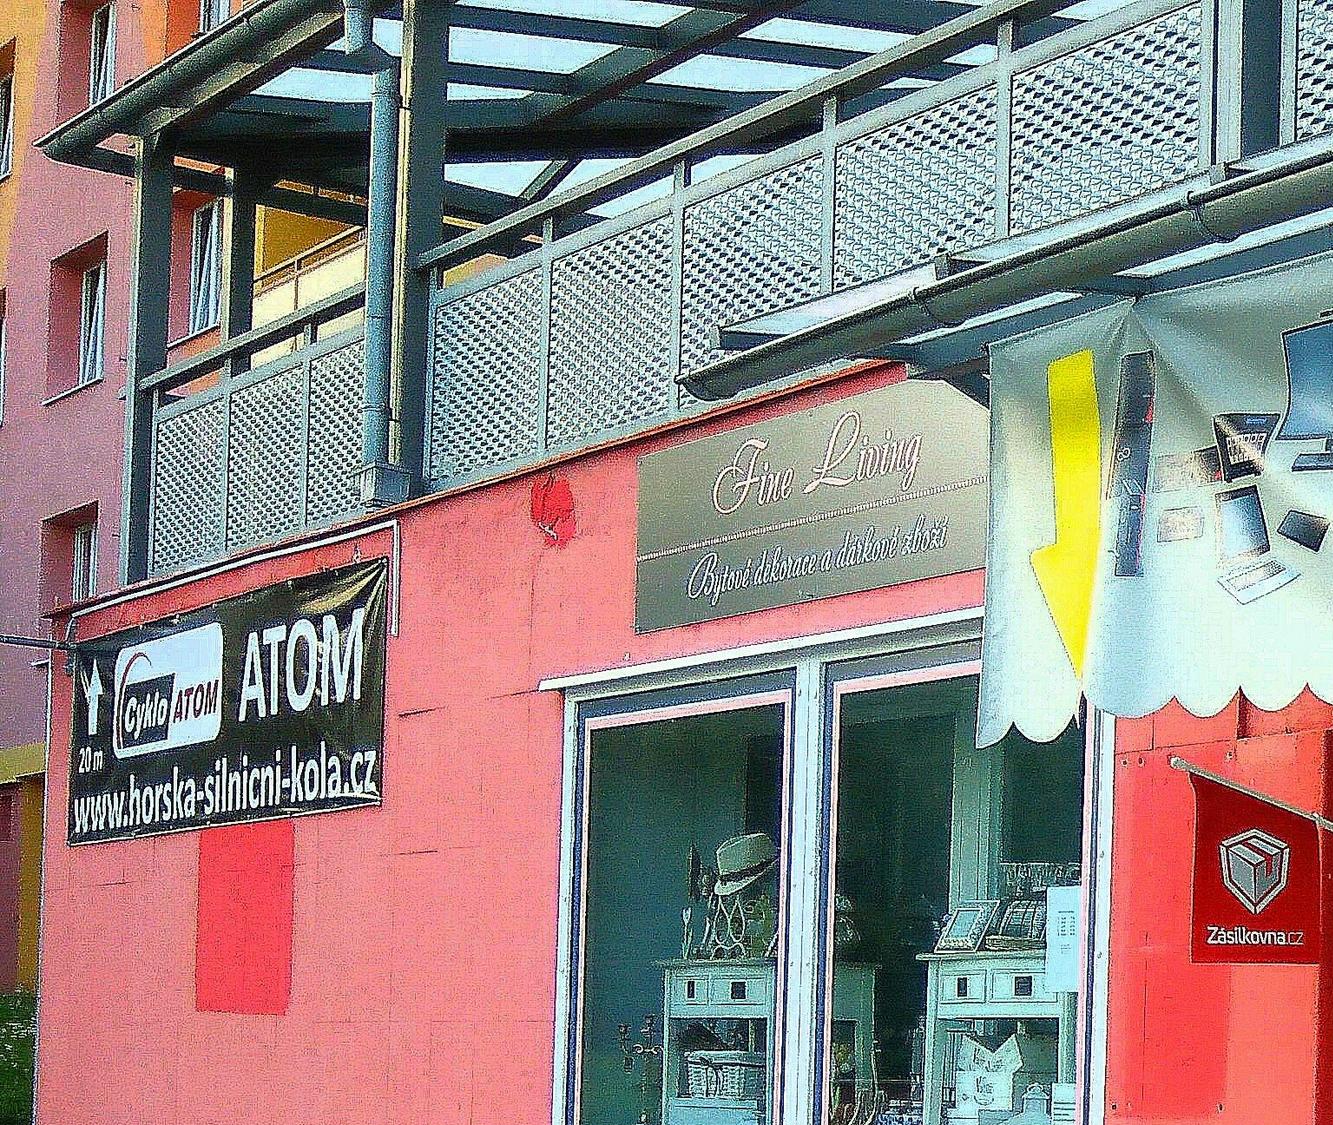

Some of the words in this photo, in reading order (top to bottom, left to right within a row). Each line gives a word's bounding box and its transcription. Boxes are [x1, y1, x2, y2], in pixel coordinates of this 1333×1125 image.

[712, 438, 795, 515] Fine
[801, 410, 924, 495] Living
[687, 551, 752, 606] Bytové
[752, 547, 817, 587] dekorace
[819, 554, 832, 572] a
[834, 524, 899, 568] dárkové
[900, 513, 950, 555] zboží
[124, 688, 168, 740] Cyklo
[173, 680, 219, 724] ATOM
[238, 608, 365, 722] ATOM
[74, 741, 377, 833] www.horska-silnicni-kola.cz
[79, 748, 91, 773] 20
[92, 752, 103, 772] m
[1206, 925, 1304, 946] Zásilkovna.cz
